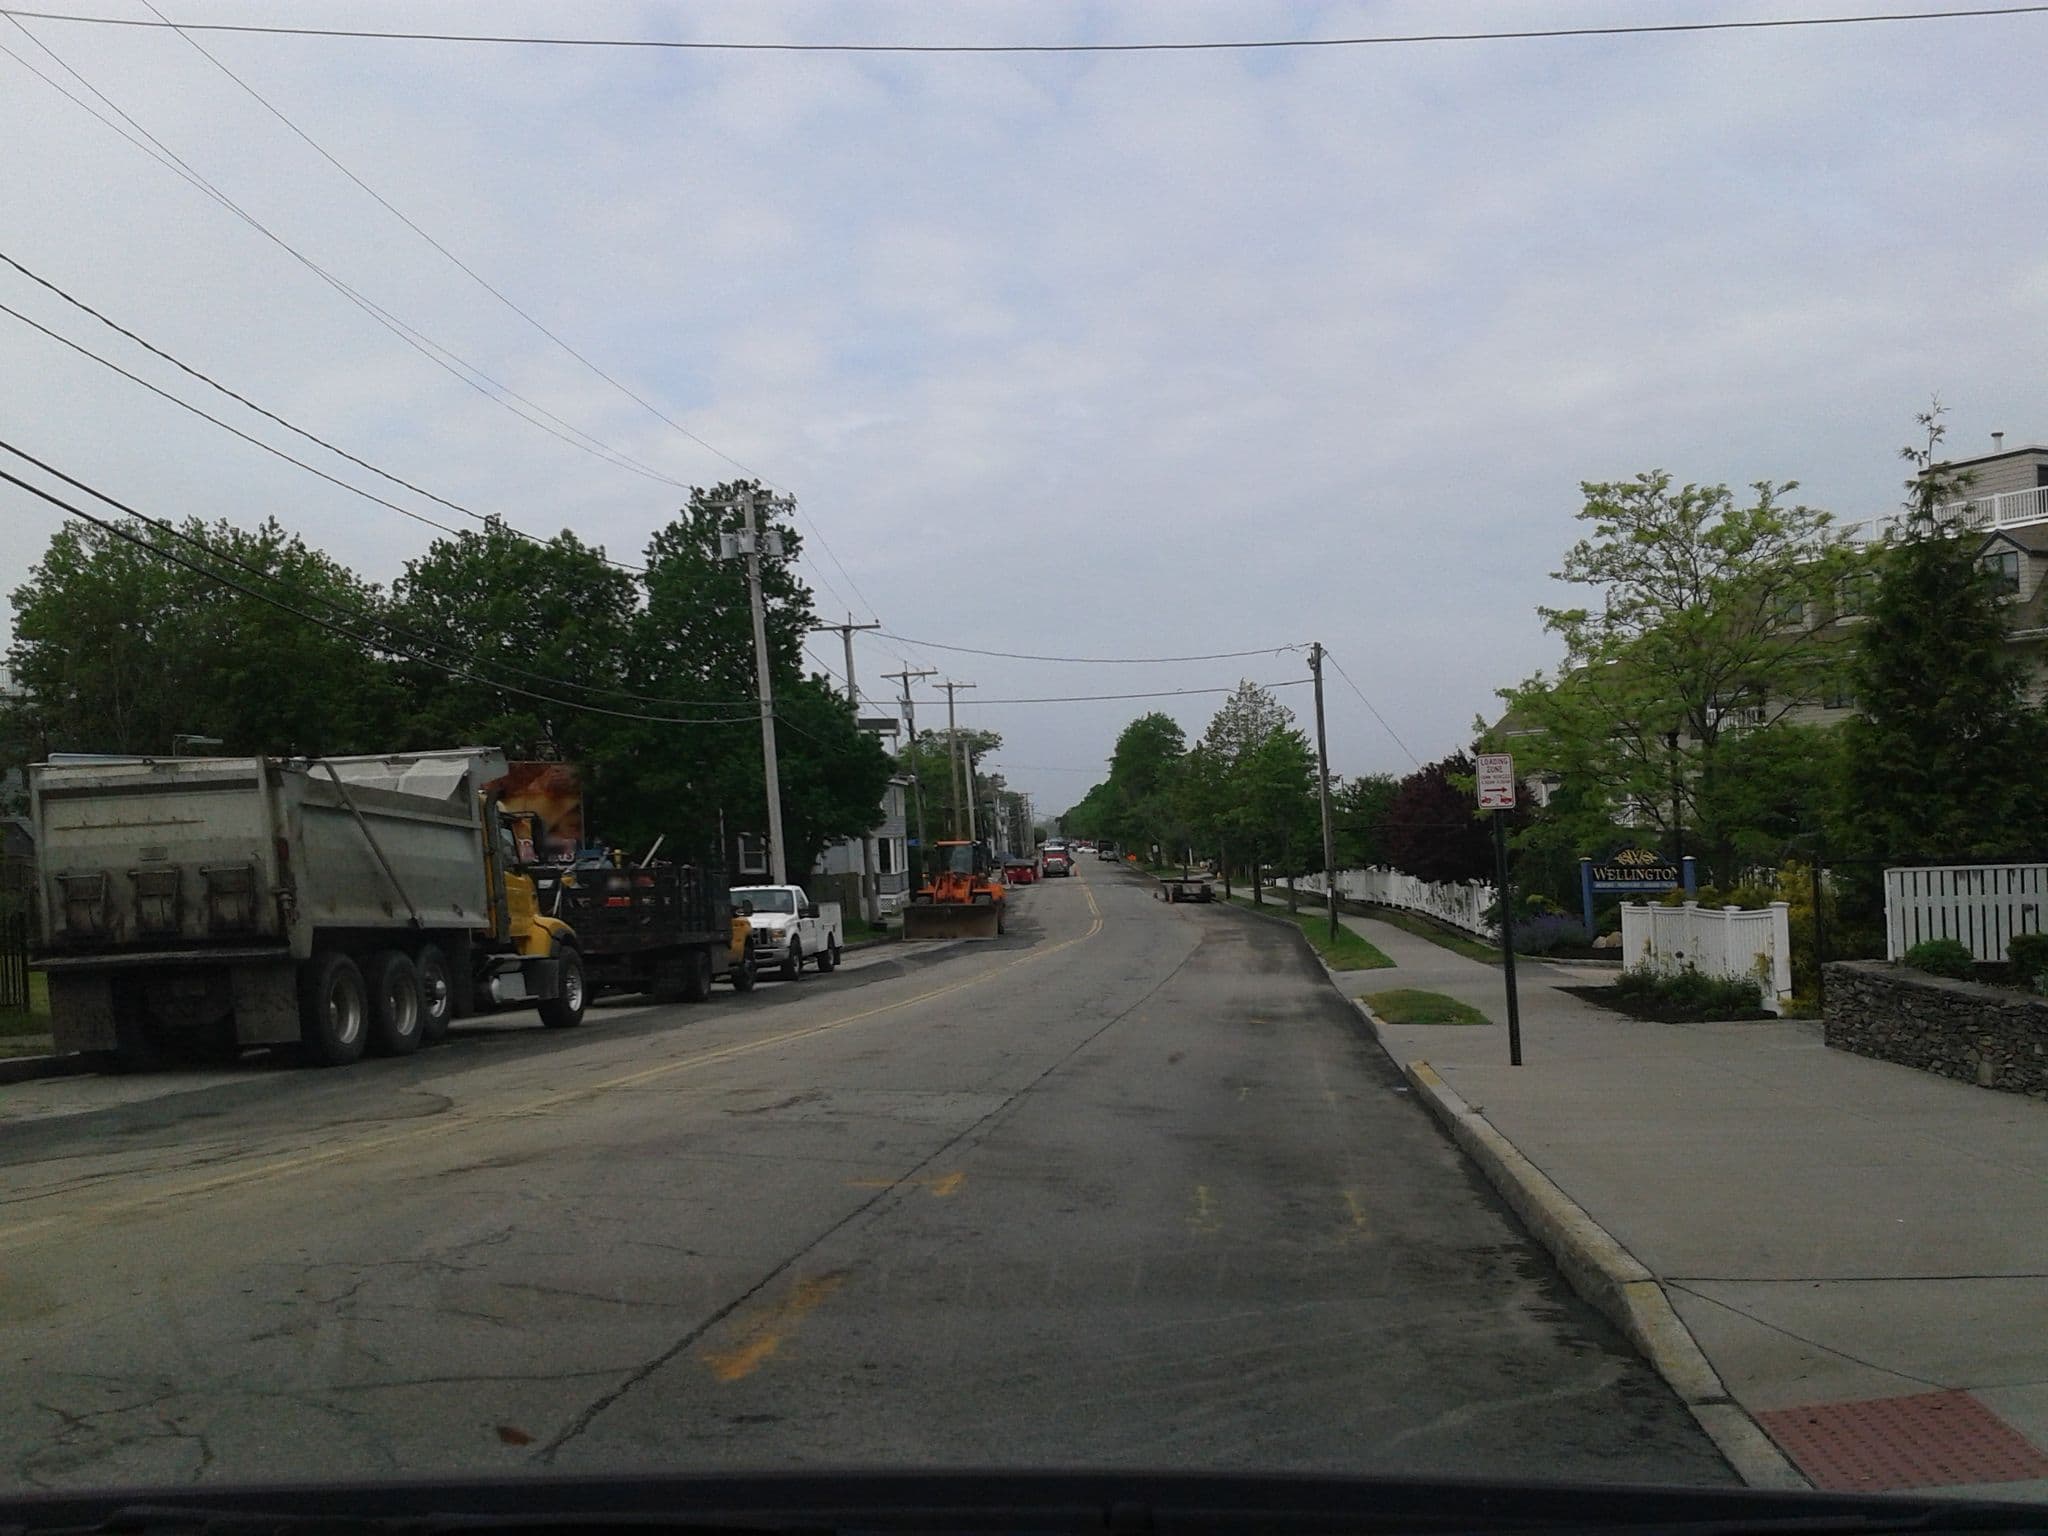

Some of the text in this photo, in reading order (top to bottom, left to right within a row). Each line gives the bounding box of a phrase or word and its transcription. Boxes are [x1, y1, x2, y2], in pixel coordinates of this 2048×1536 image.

[1480, 758, 1508, 766] LOADING
[1487, 765, 1503, 773] ZONE
[1593, 866, 1678, 881] WELLINGTON
